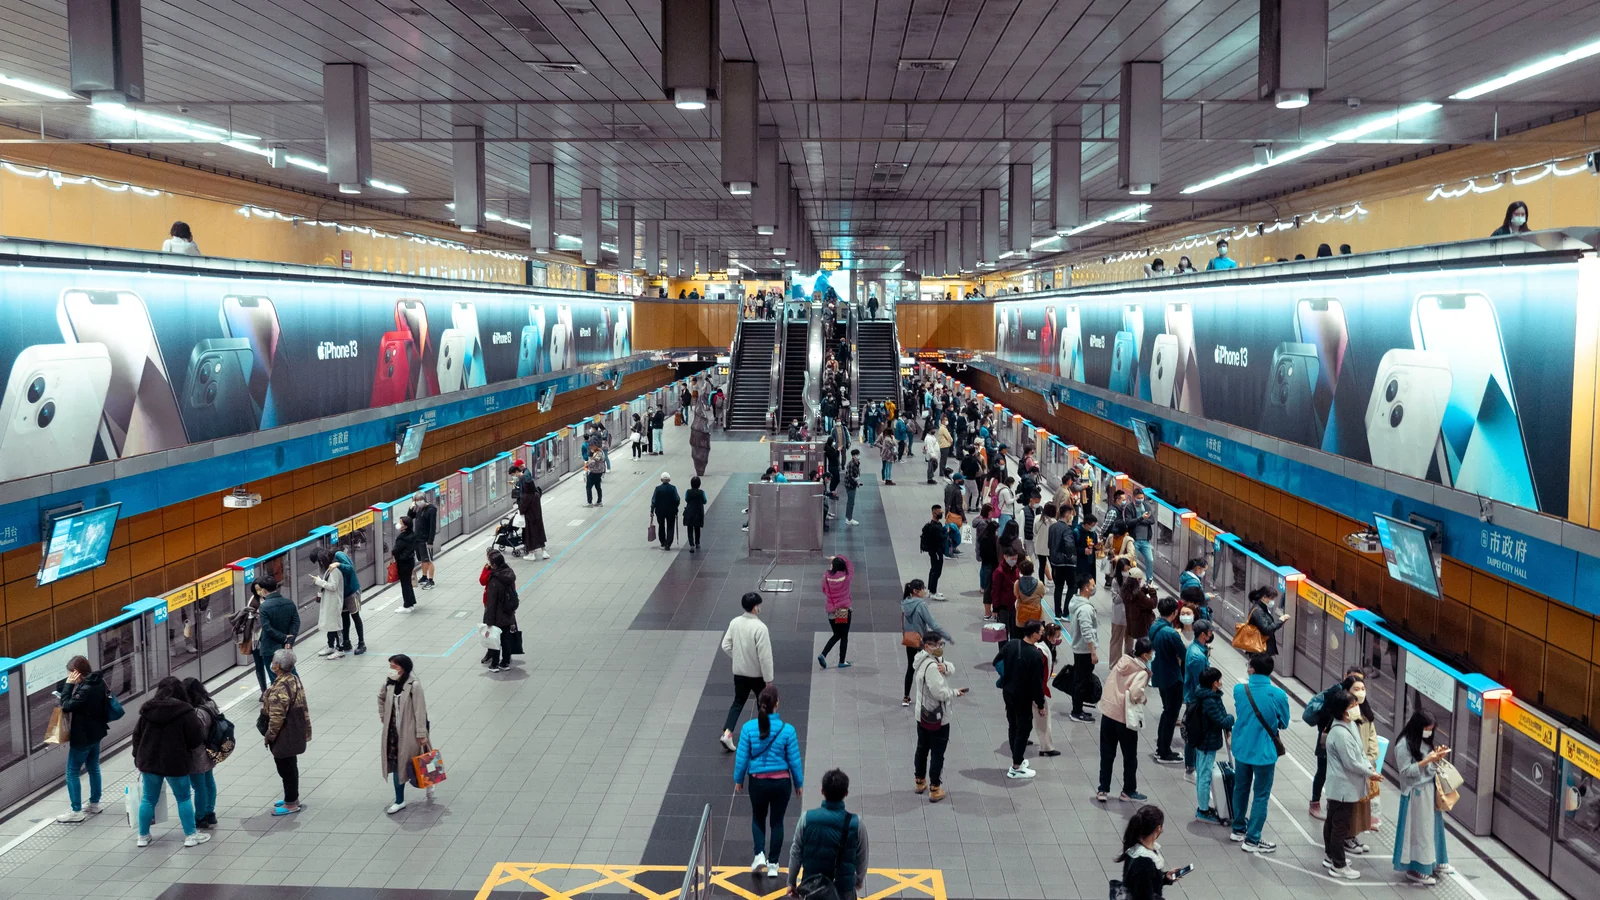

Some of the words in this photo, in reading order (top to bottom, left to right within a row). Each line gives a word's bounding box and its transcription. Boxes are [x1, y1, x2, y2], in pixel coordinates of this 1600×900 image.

[324, 341, 350, 359] iPhone
[349, 340, 358, 358] 13
[1218, 345, 1240, 366] iPhone
[1240, 347, 1248, 368] 13
[1490, 531, 1528, 564] 市政府
[1487, 556, 1502, 569] TAIPEI
[1502, 562, 1514, 574] CITY
[1514, 566, 1527, 579] HALL
[162, 606, 167, 618] 3
[1, 675, 8, 690] 3
[1475, 697, 1482, 713] 4
